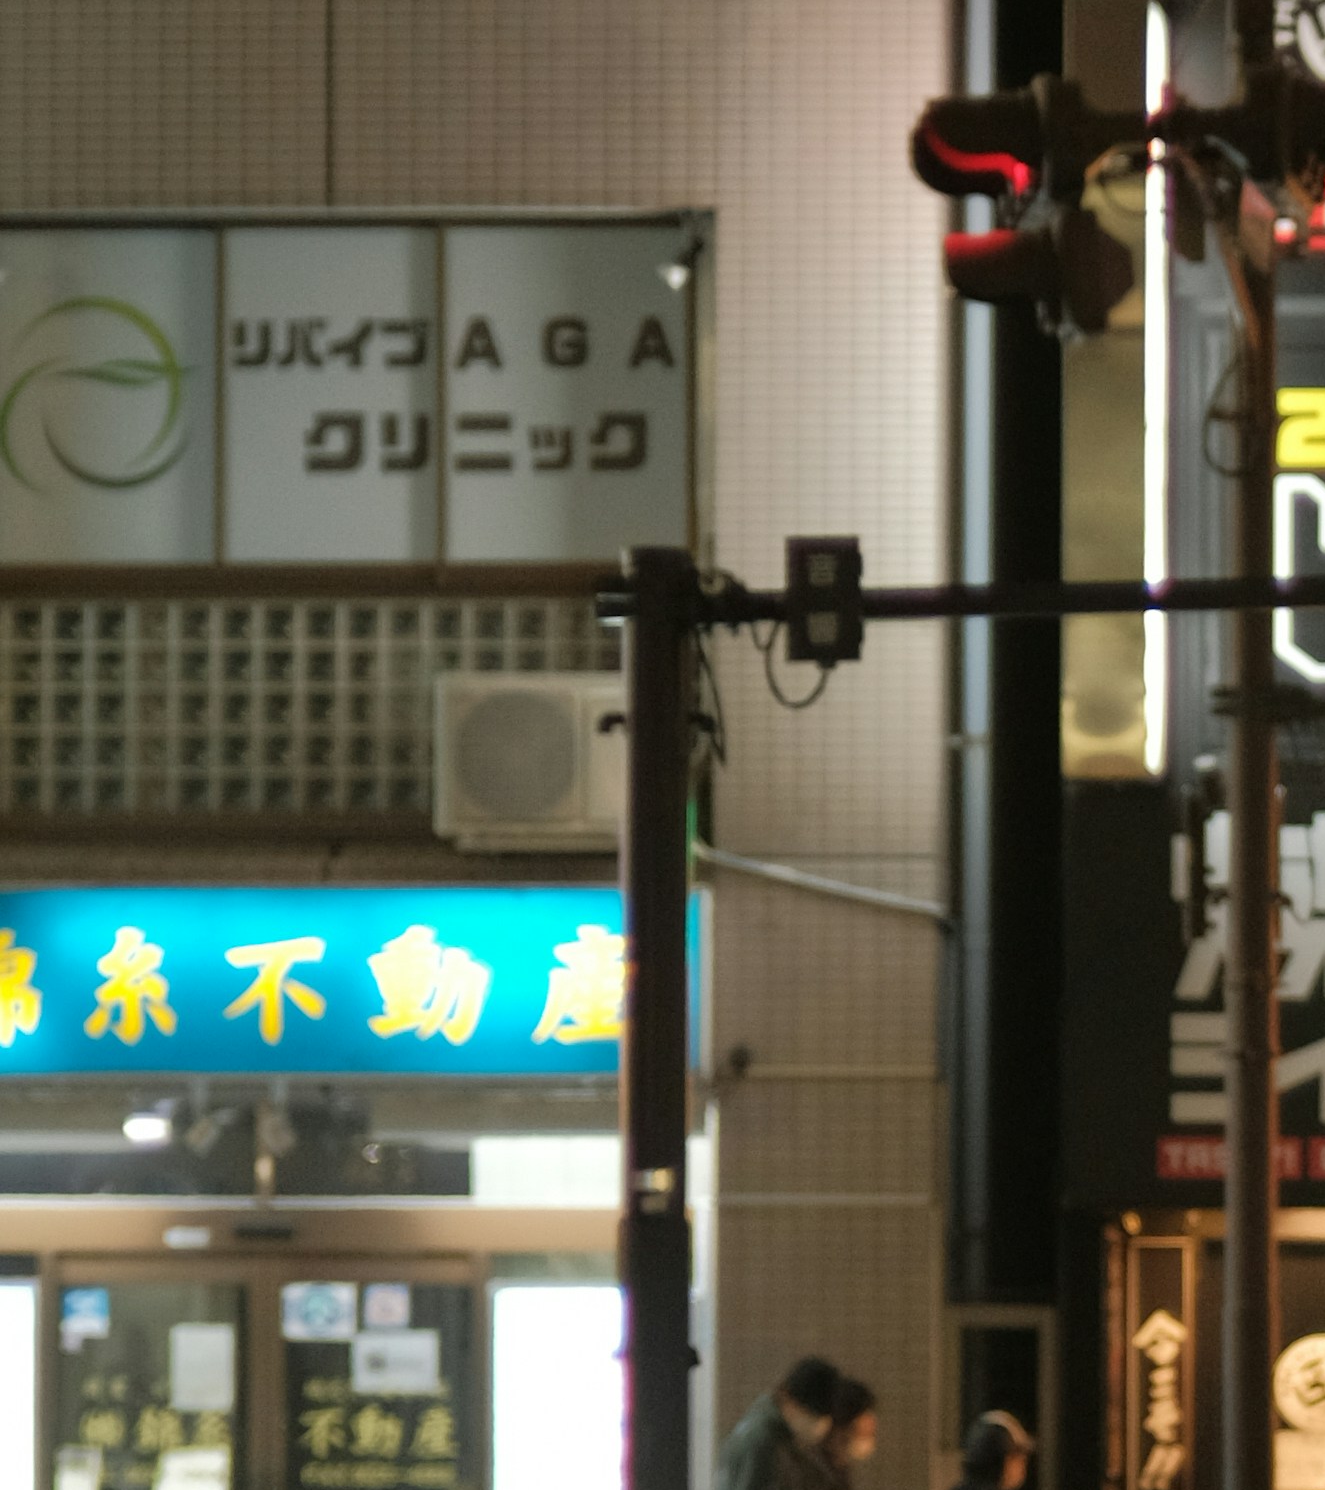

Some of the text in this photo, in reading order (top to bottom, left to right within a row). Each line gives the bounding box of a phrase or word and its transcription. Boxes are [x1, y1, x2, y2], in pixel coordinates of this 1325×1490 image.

[305, 414, 648, 472] クリニック
